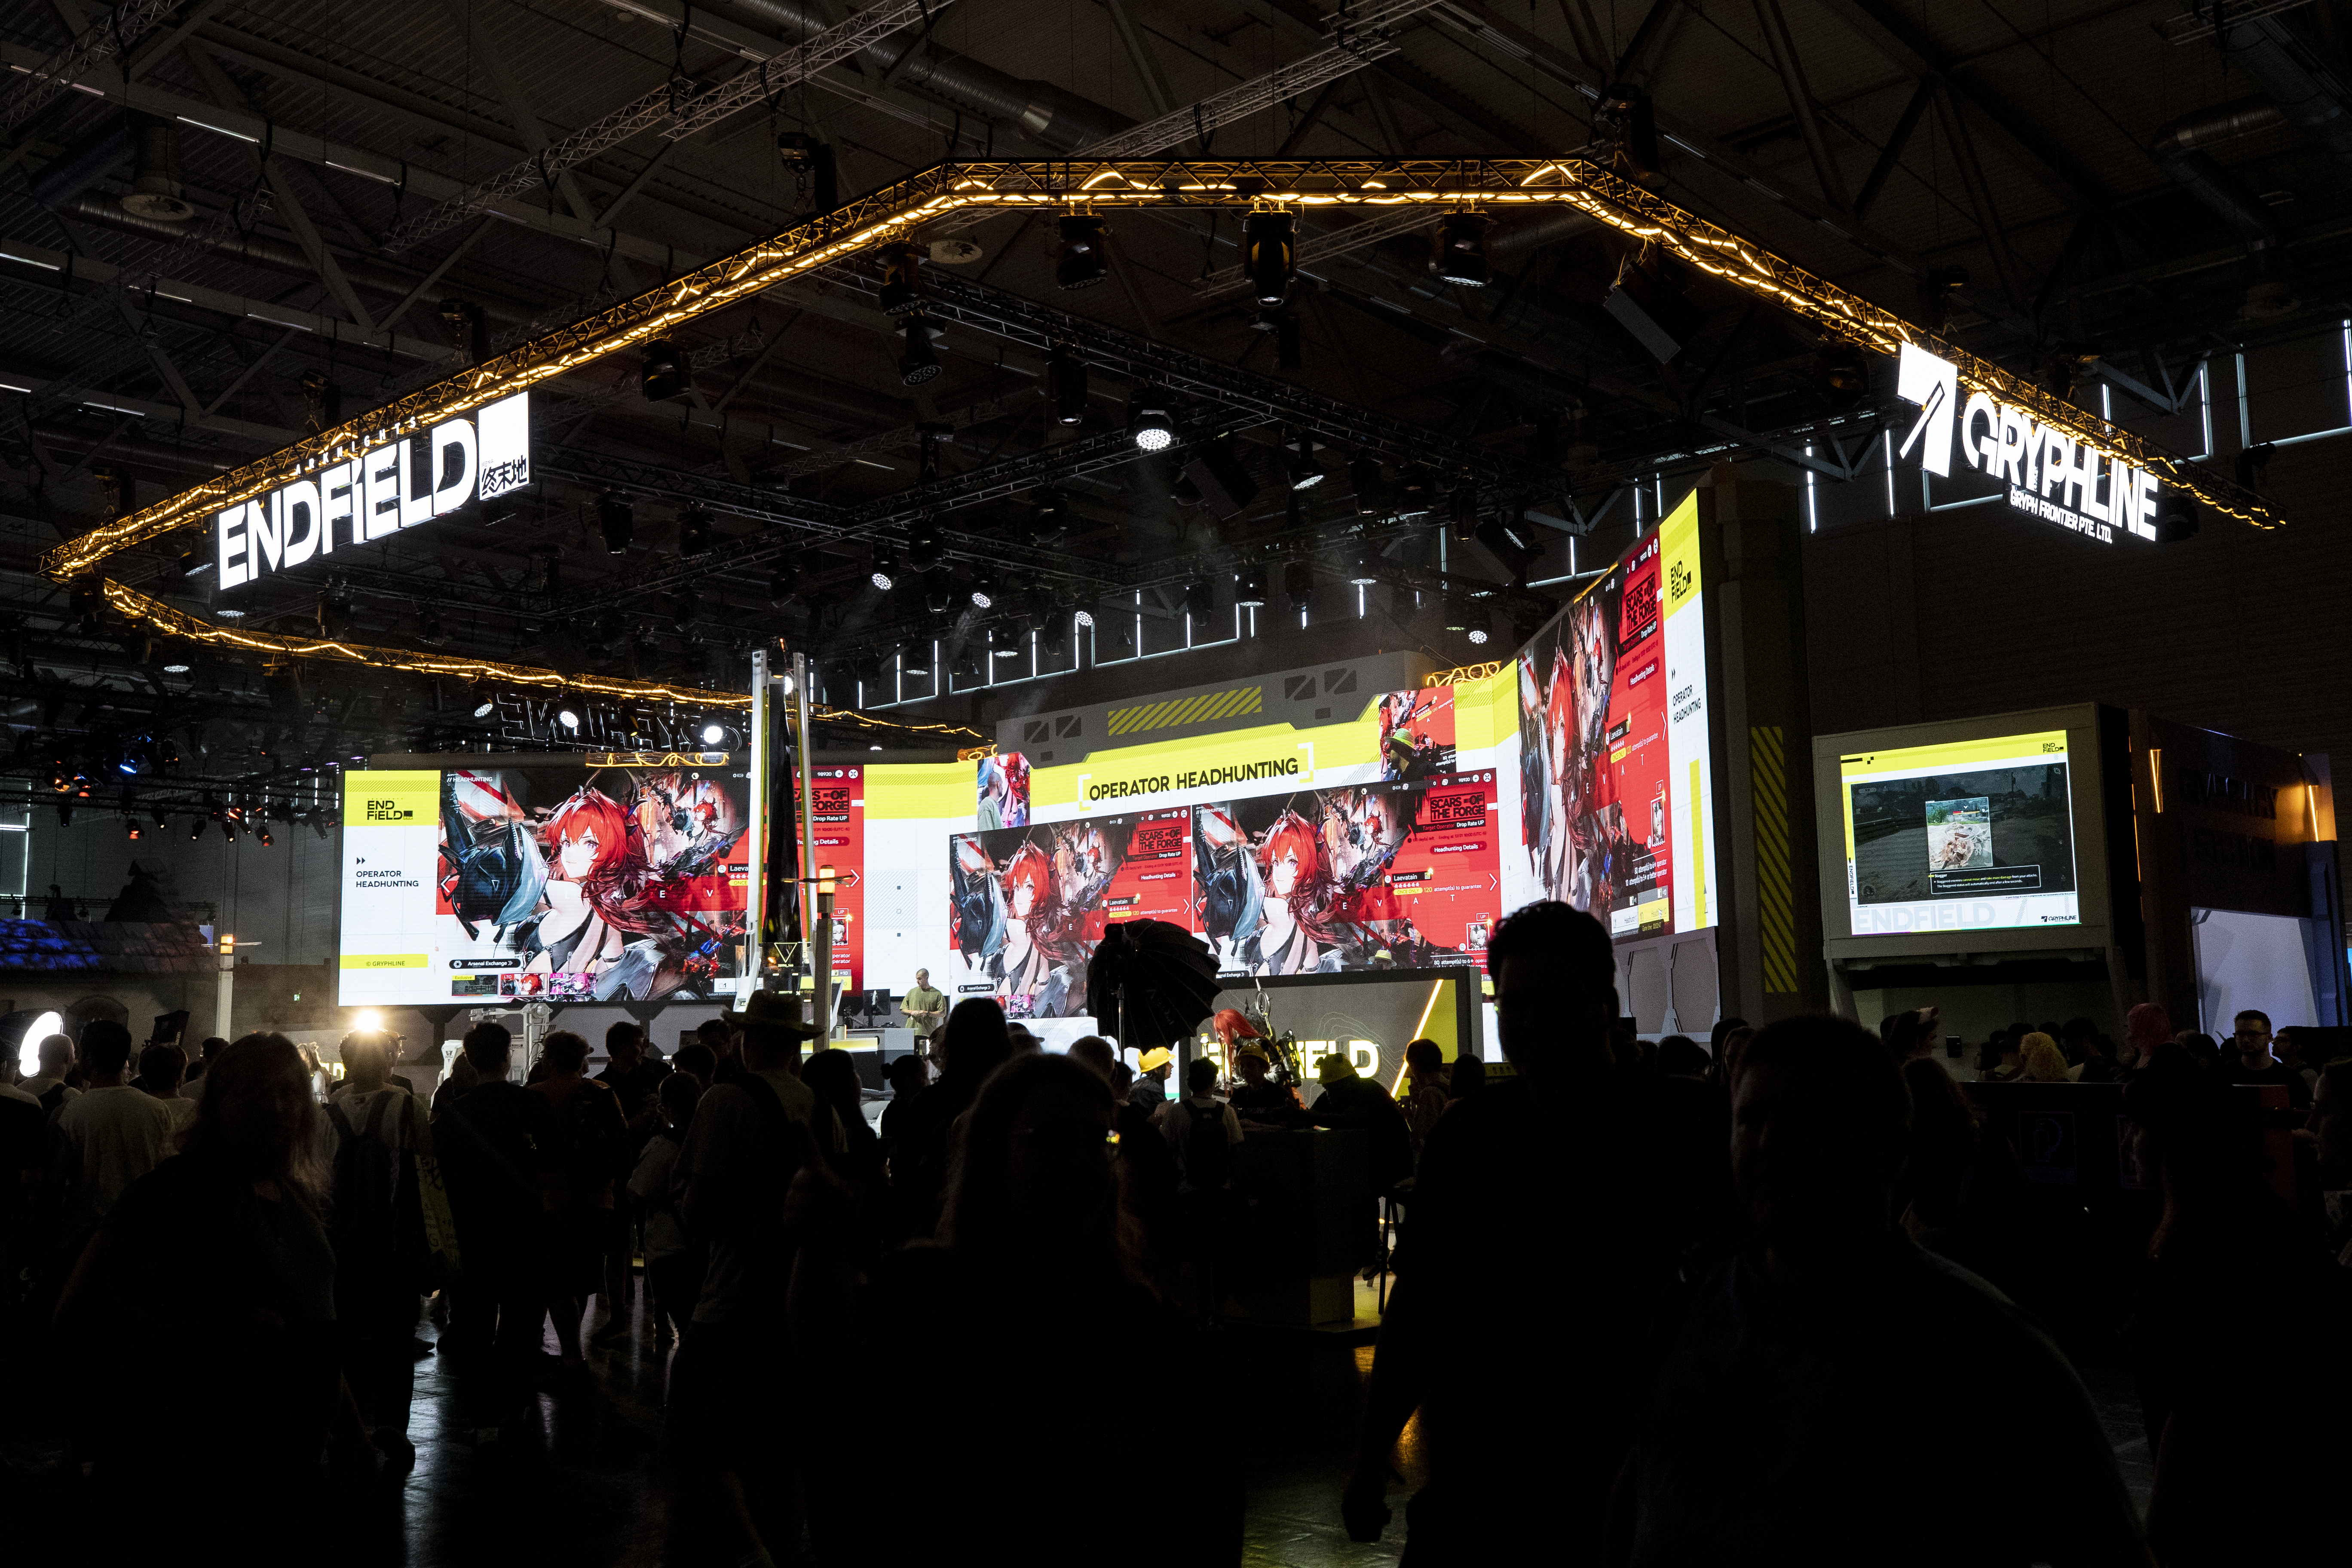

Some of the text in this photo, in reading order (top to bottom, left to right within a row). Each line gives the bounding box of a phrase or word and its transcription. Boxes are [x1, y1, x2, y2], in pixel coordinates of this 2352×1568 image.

[296, 416, 417, 475] ARKNIGHTS
[1962, 392, 2158, 542] GRYPHLINE
[2010, 490, 2038, 515] GRYPH
[2039, 500, 2077, 532] FRONTIER
[2096, 524, 2113, 544] LTD.
[1671, 560, 1683, 585] END
[1627, 594, 1656, 632] THE FORGE
[1630, 663, 1654, 686] Headhunting Details
[1672, 685, 1693, 706] OPERATOR
[1673, 698, 1701, 725] HEADHUNTING
[1089, 757, 1298, 801] OPERATOR HEADHUNTING
[367, 800, 395, 810] END
[1431, 794, 1484, 809] SCARS OF
[1431, 805, 1485, 820] THE FORGE
[1139, 830, 1164, 842] SCARS
[1139, 838, 1182, 851] THE FORGE
[706, 889, 714, 897] V
[1853, 902, 1996, 933] ENDFIELD
